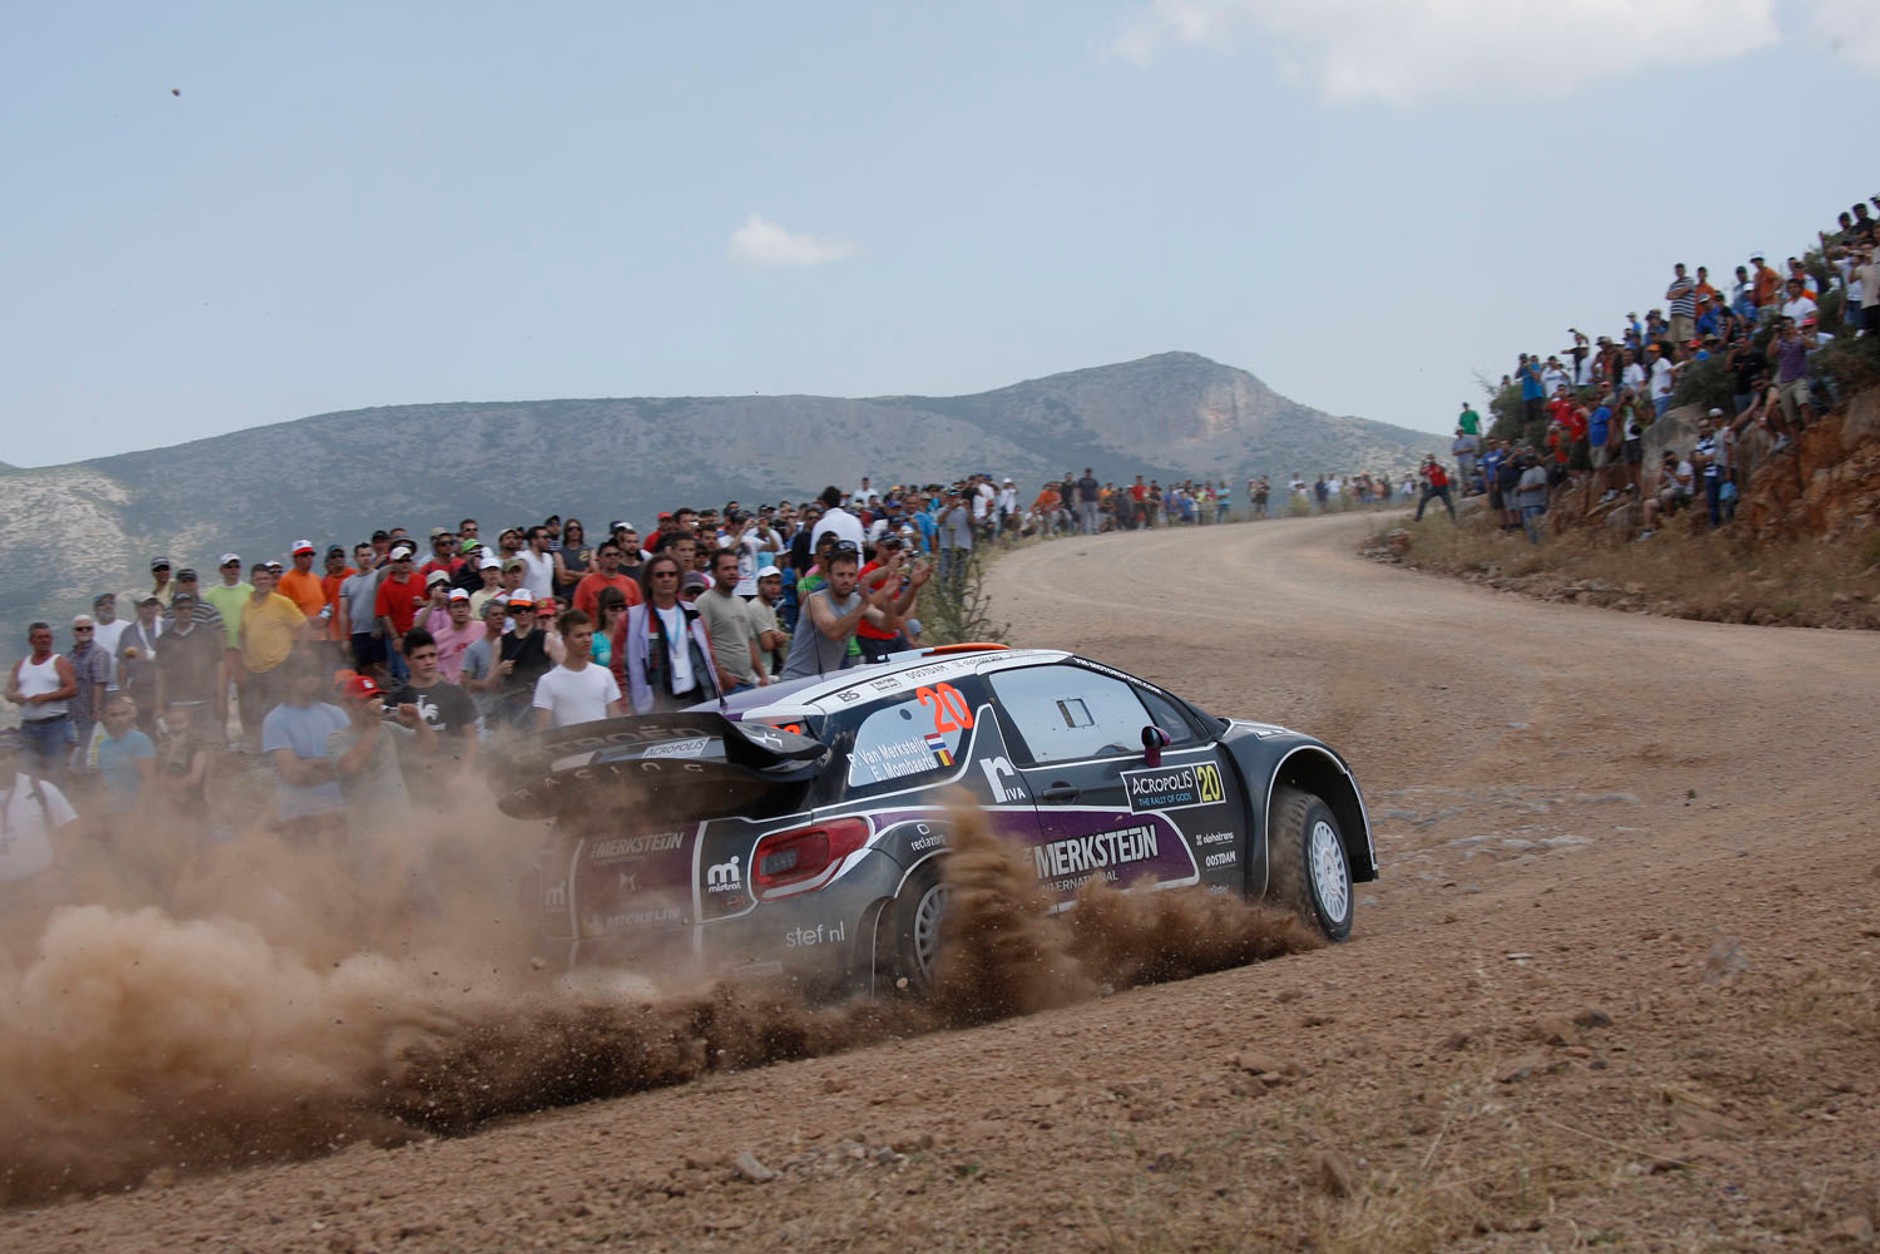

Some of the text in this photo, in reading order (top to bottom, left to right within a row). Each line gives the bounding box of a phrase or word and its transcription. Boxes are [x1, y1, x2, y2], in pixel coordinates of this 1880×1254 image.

[916, 682, 974, 734] 20
[645, 739, 705, 758] ACROPOLIS
[857, 748, 881, 765] Van
[877, 737, 931, 761] Merksteijn
[882, 756, 939, 779] Mombaerts
[1132, 764, 1221, 802] ACROPOLIS 20
[1138, 792, 1193, 807] THE RALLY OF GODS
[1033, 824, 1159, 879] MERKSTEIJN
[1205, 850, 1236, 867] OOSTDAM
[708, 881, 742, 893] mistral
